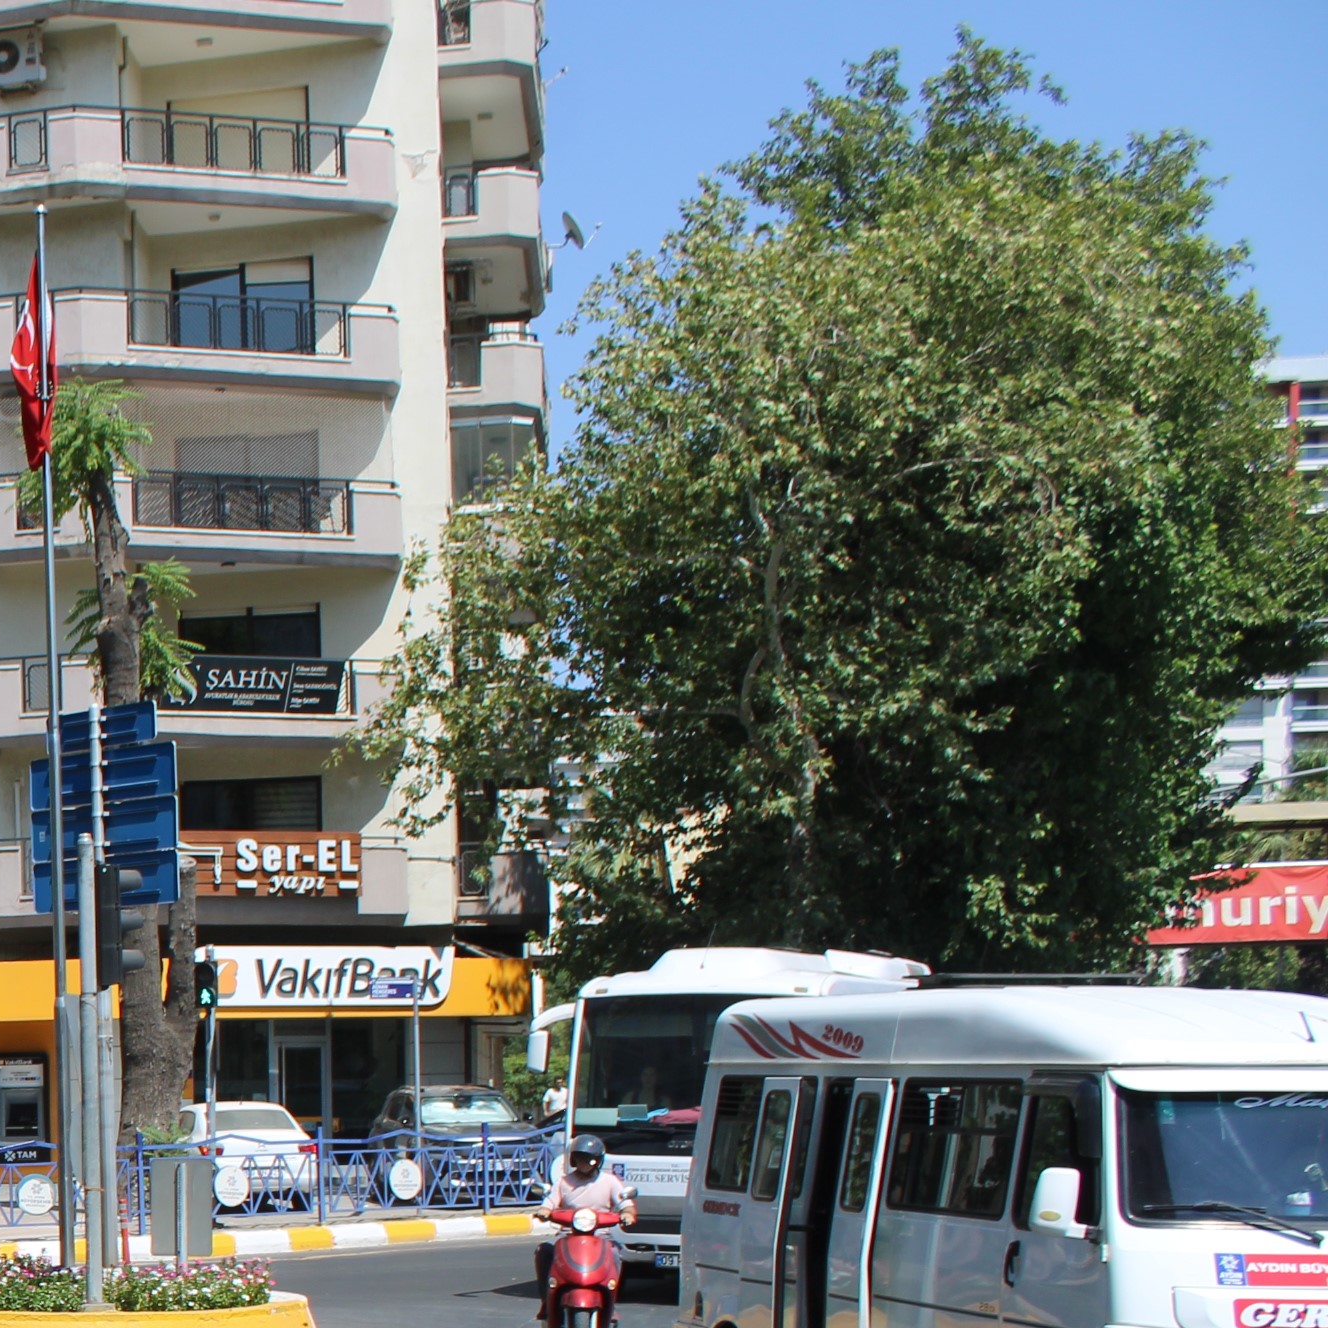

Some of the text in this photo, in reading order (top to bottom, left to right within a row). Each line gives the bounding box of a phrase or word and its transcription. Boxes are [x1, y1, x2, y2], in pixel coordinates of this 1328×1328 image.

[206, 667, 289, 690] ŞAHİN
[236, 838, 359, 873] Ser-EL
[268, 874, 326, 894] yapı
[822, 1024, 864, 1053] 2009
[17, 1151, 37, 1159] TAM
[625, 1171, 653, 1182] ÖZEL
[1247, 1262, 1296, 1274] AYDIN
